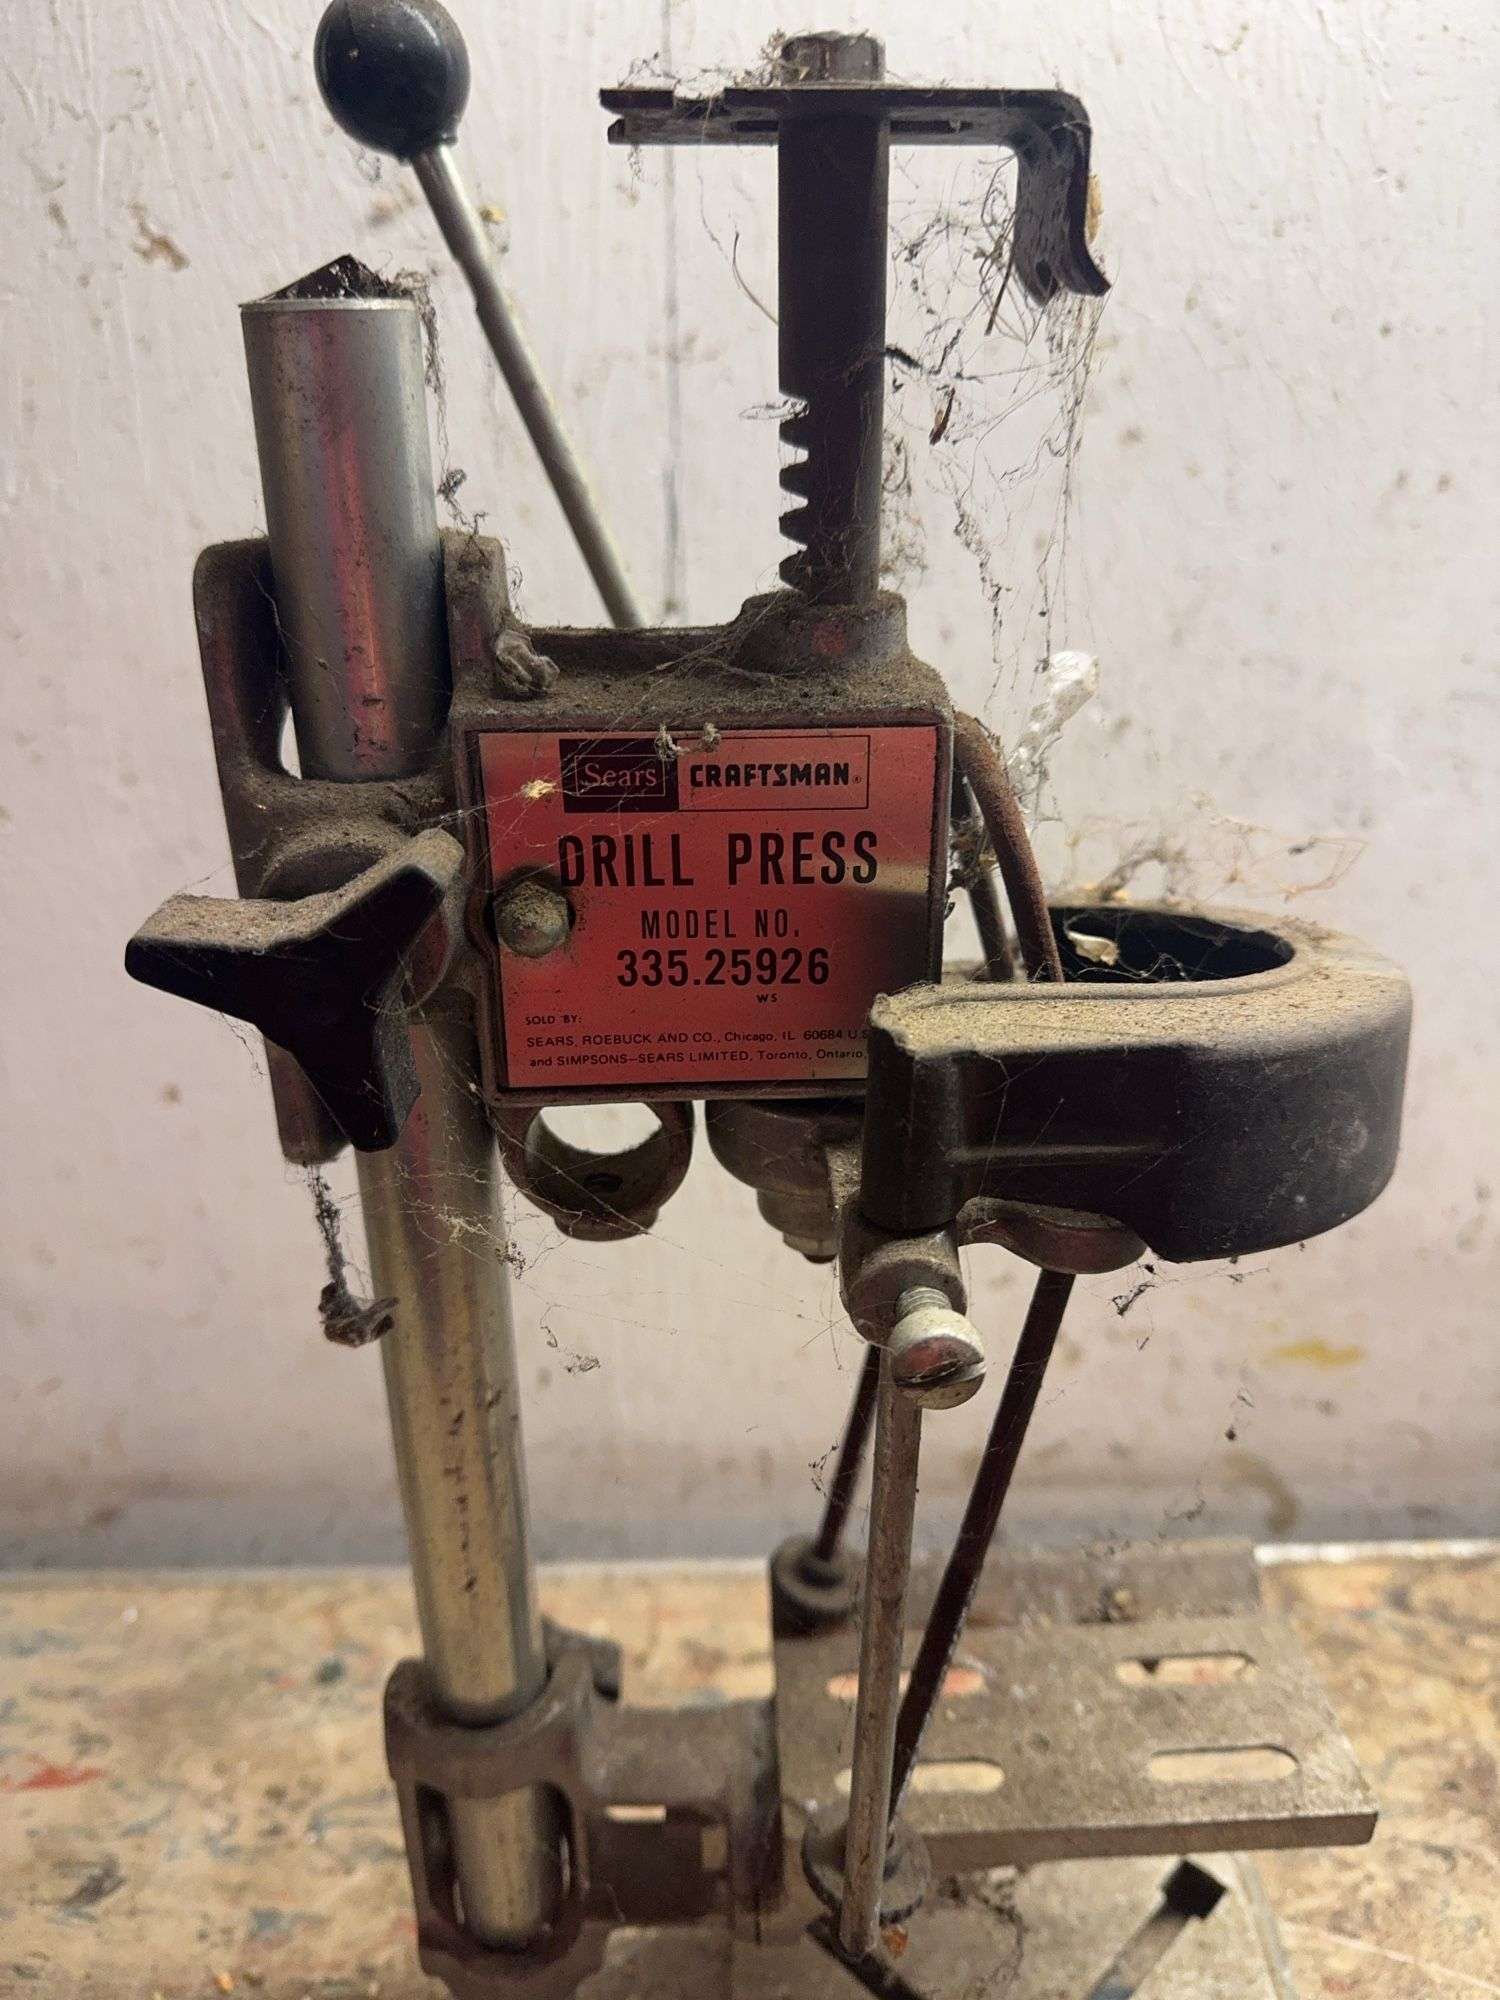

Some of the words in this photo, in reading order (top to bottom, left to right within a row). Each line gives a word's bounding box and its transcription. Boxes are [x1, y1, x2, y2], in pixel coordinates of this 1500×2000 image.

[584, 761, 657, 787] Sears
[558, 833, 694, 886] DRILL
[728, 831, 878, 885] PRESS
[641, 910, 737, 939] MODEL
[755, 909, 800, 937] NO.
[616, 948, 829, 986] 335.25926
[525, 1015, 556, 1026] SOLD
[563, 1014, 582, 1024] BY:
[582, 1034, 652, 1045] ROEBUCK
[657, 1033, 689, 1043] AND
[724, 1031, 777, 1042] Chicago,
[782, 1030, 795, 1041] IL
[803, 1029, 842, 1040] 60684
[530, 1057, 553, 1067] and
[759, 1051, 812, 1061] Toronto,
